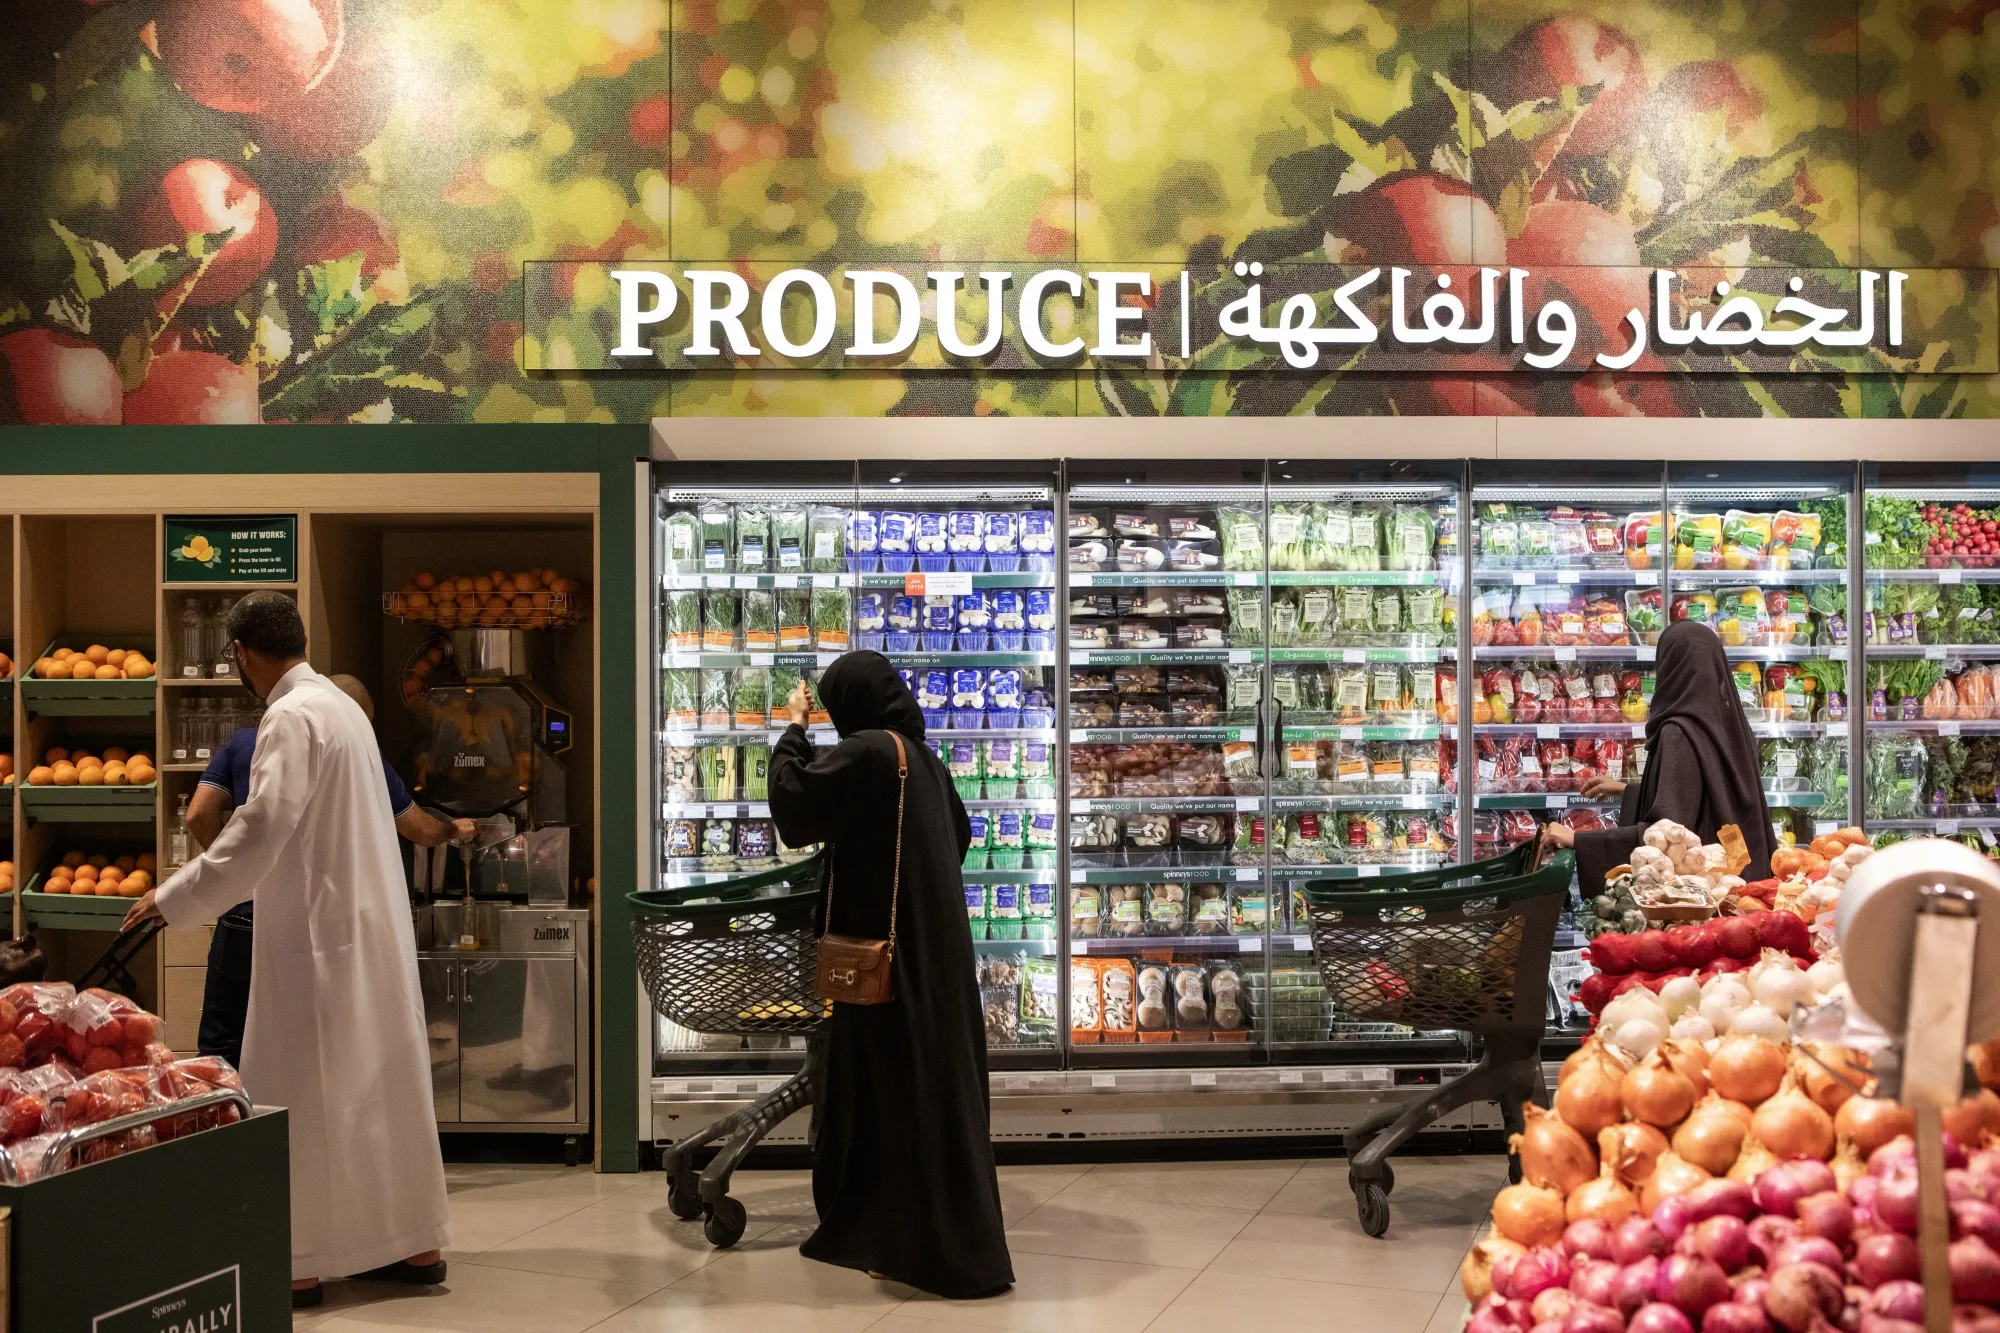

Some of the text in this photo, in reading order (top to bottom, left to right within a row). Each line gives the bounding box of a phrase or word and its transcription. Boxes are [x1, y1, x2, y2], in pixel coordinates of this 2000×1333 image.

[610, 268, 1152, 357] PRODUCE
[1219, 261, 1909, 370] الخضار والفاكهة
[259, 531, 287, 539] WORKS:
[889, 577, 900, 586] put
[1132, 577, 1156, 587] Quality
[1157, 577, 1176, 585] we've
[1177, 577, 1188, 586] put
[1270, 575, 1299, 585] rganic
[1307, 575, 1339, 584] Organic
[1348, 575, 1381, 584] Organic
[1150, 654, 1174, 662] Quality
[1194, 654, 1204, 662] put
[1283, 651, 1316, 661] Organic
[749, 736, 769, 744] Qualit
[1131, 732, 1155, 741] Quality
[1176, 732, 1186, 740] put
[454, 753, 485, 767] zümex
[1150, 803, 1174, 812] Quality
[1174, 802, 1193, 810] we've
[1194, 803, 1204, 811] put
[1275, 799, 1322, 809] spinneysFOOD
[1340, 799, 1363, 807] Quality
[1384, 799, 1394, 807] put
[1163, 869, 1210, 879] spinneysFOOD
[1273, 869, 1283, 877] put
[152, 1298, 187, 1320] Spinneys
